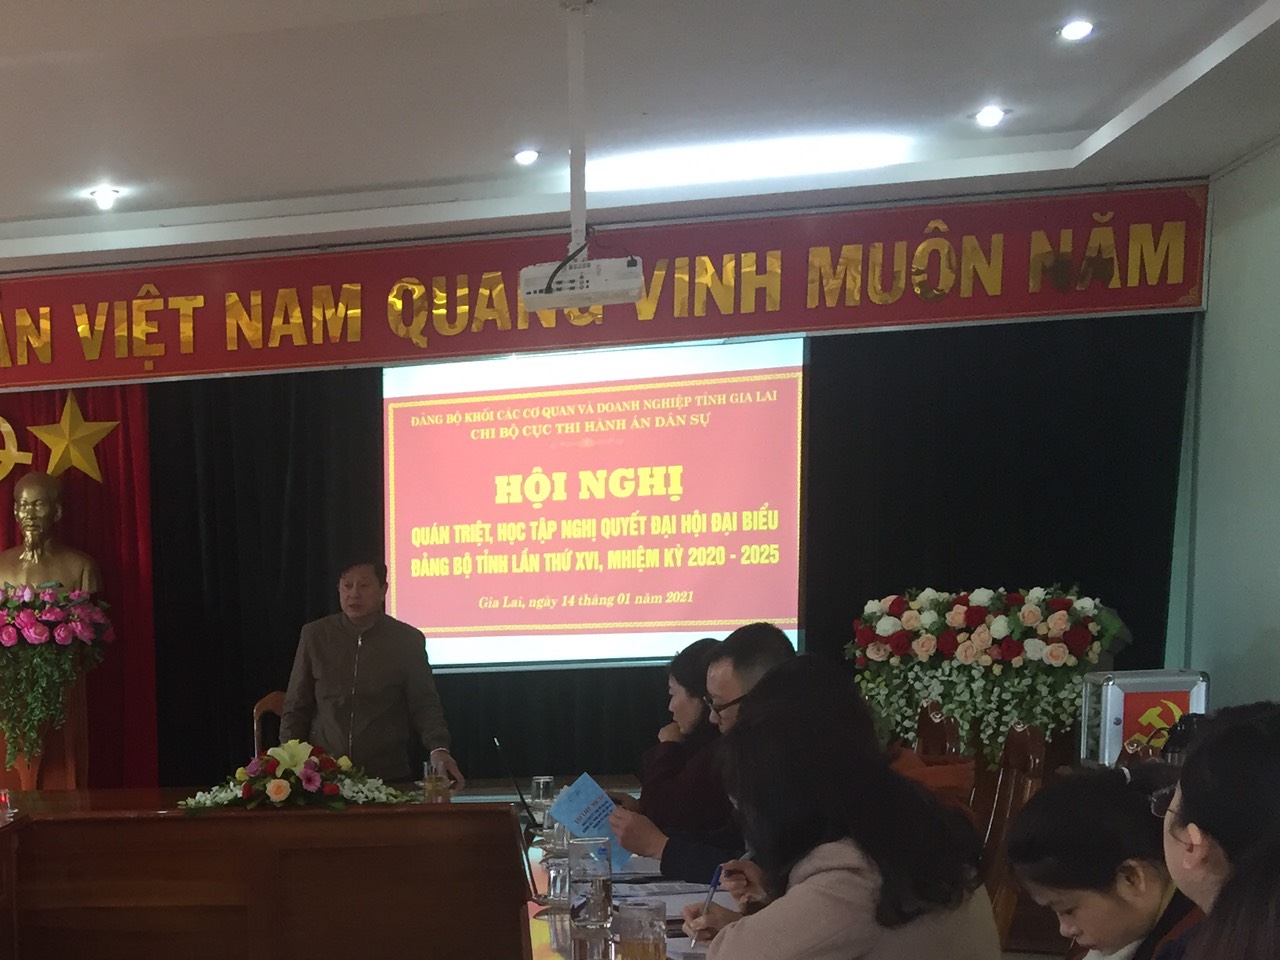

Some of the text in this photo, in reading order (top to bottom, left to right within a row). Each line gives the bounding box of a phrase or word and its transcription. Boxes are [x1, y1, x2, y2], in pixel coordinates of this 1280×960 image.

[73, 284, 206, 370] VIỆT
[226, 283, 362, 351] NAM
[633, 250, 781, 320] VINH
[807, 220, 1005, 309] MUÔN
[1029, 212, 1185, 291] NĂM
[446, 410, 462, 426] BỘ
[465, 407, 494, 423] KHỐI
[497, 406, 520, 420] CÁC
[523, 408, 540, 419] CƠ
[542, 405, 575, 419] QUAN
[578, 401, 594, 415] VÀ
[597, 400, 640, 413] DOANH
[643, 395, 692, 410] NGHIỆP
[729, 392, 752, 404] GIA
[756, 390, 777, 402] LAI
[470, 428, 496, 440] CHI
[499, 424, 519, 440] BỘ
[522, 424, 552, 438] CỤC
[555, 422, 581, 434] THI
[585, 415, 626, 433] HÀNH
[630, 414, 651, 429] ÁN
[690, 411, 711, 427] SỰ
[494, 465, 683, 509] HỘI NGHỊ
[411, 502, 779, 548] QUÁN TRIỆT, HỌC TẬP NGHỊ QUYẾT ĐẠI HỘI ĐẠI BIỂU
[411, 552, 449, 577] ĐẢNG
[453, 552, 472, 579] BỘ
[476, 549, 508, 574] TỈNH
[543, 548, 573, 572] THỨ
[575, 551, 603, 572] XVI,
[664, 543, 684, 567] KỲ
[687, 546, 726, 567] 2020
[740, 544, 780, 565] 2025
[478, 591, 694, 610] Gia Lai, ngày 14 tháng 01 năm 2021
